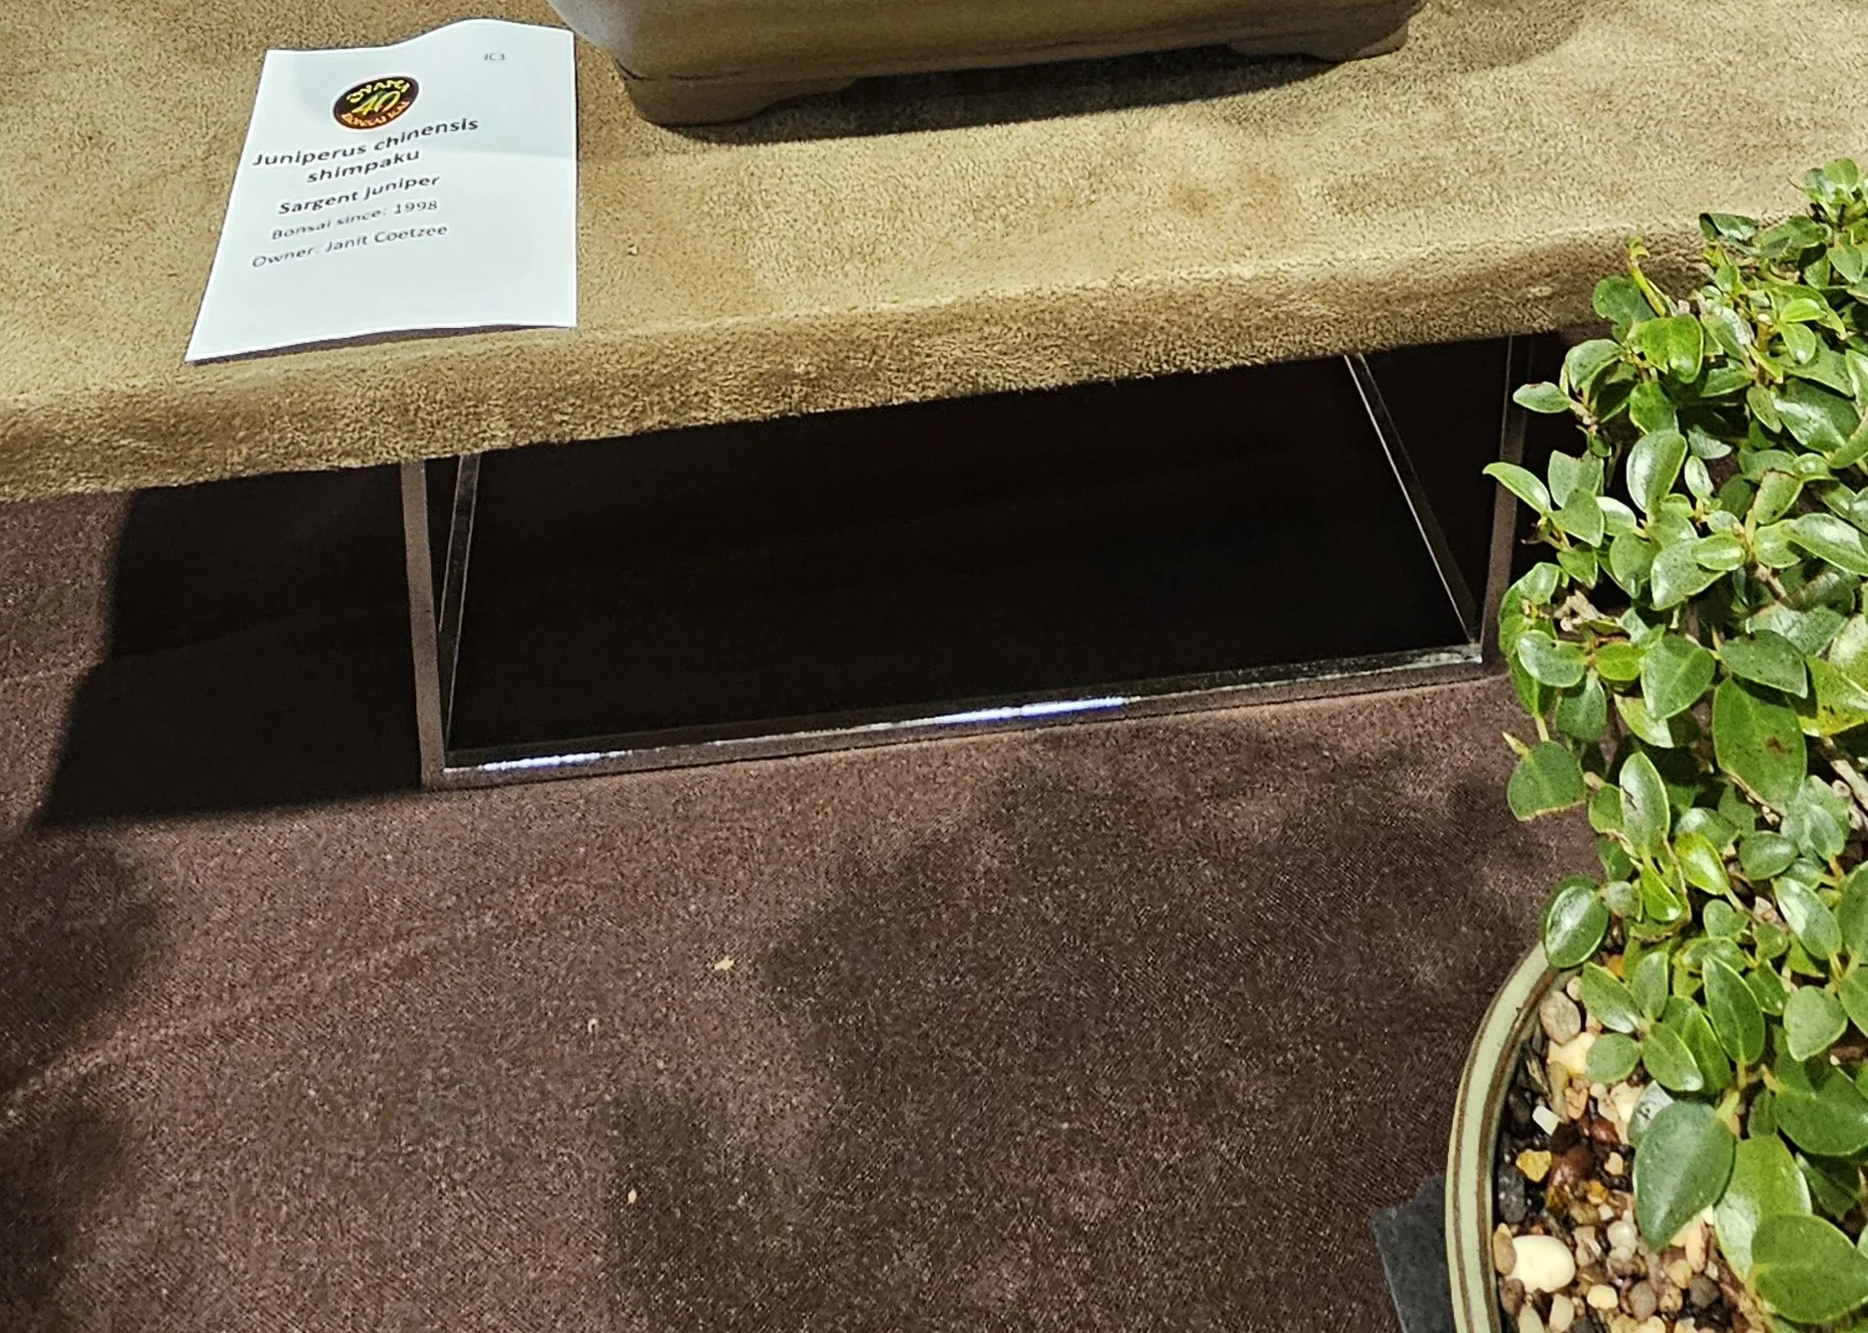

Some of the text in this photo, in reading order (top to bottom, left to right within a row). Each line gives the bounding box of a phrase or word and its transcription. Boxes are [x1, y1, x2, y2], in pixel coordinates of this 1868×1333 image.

[252, 117, 478, 166] Juniperus chinensis
[306, 150, 419, 183] shimpaku
[278, 191, 359, 215] Sargent
[271, 220, 331, 240] Bonsai
[394, 200, 438, 215] 1998
[325, 235, 368, 253] Janit
[374, 225, 449, 243] Coetzee
